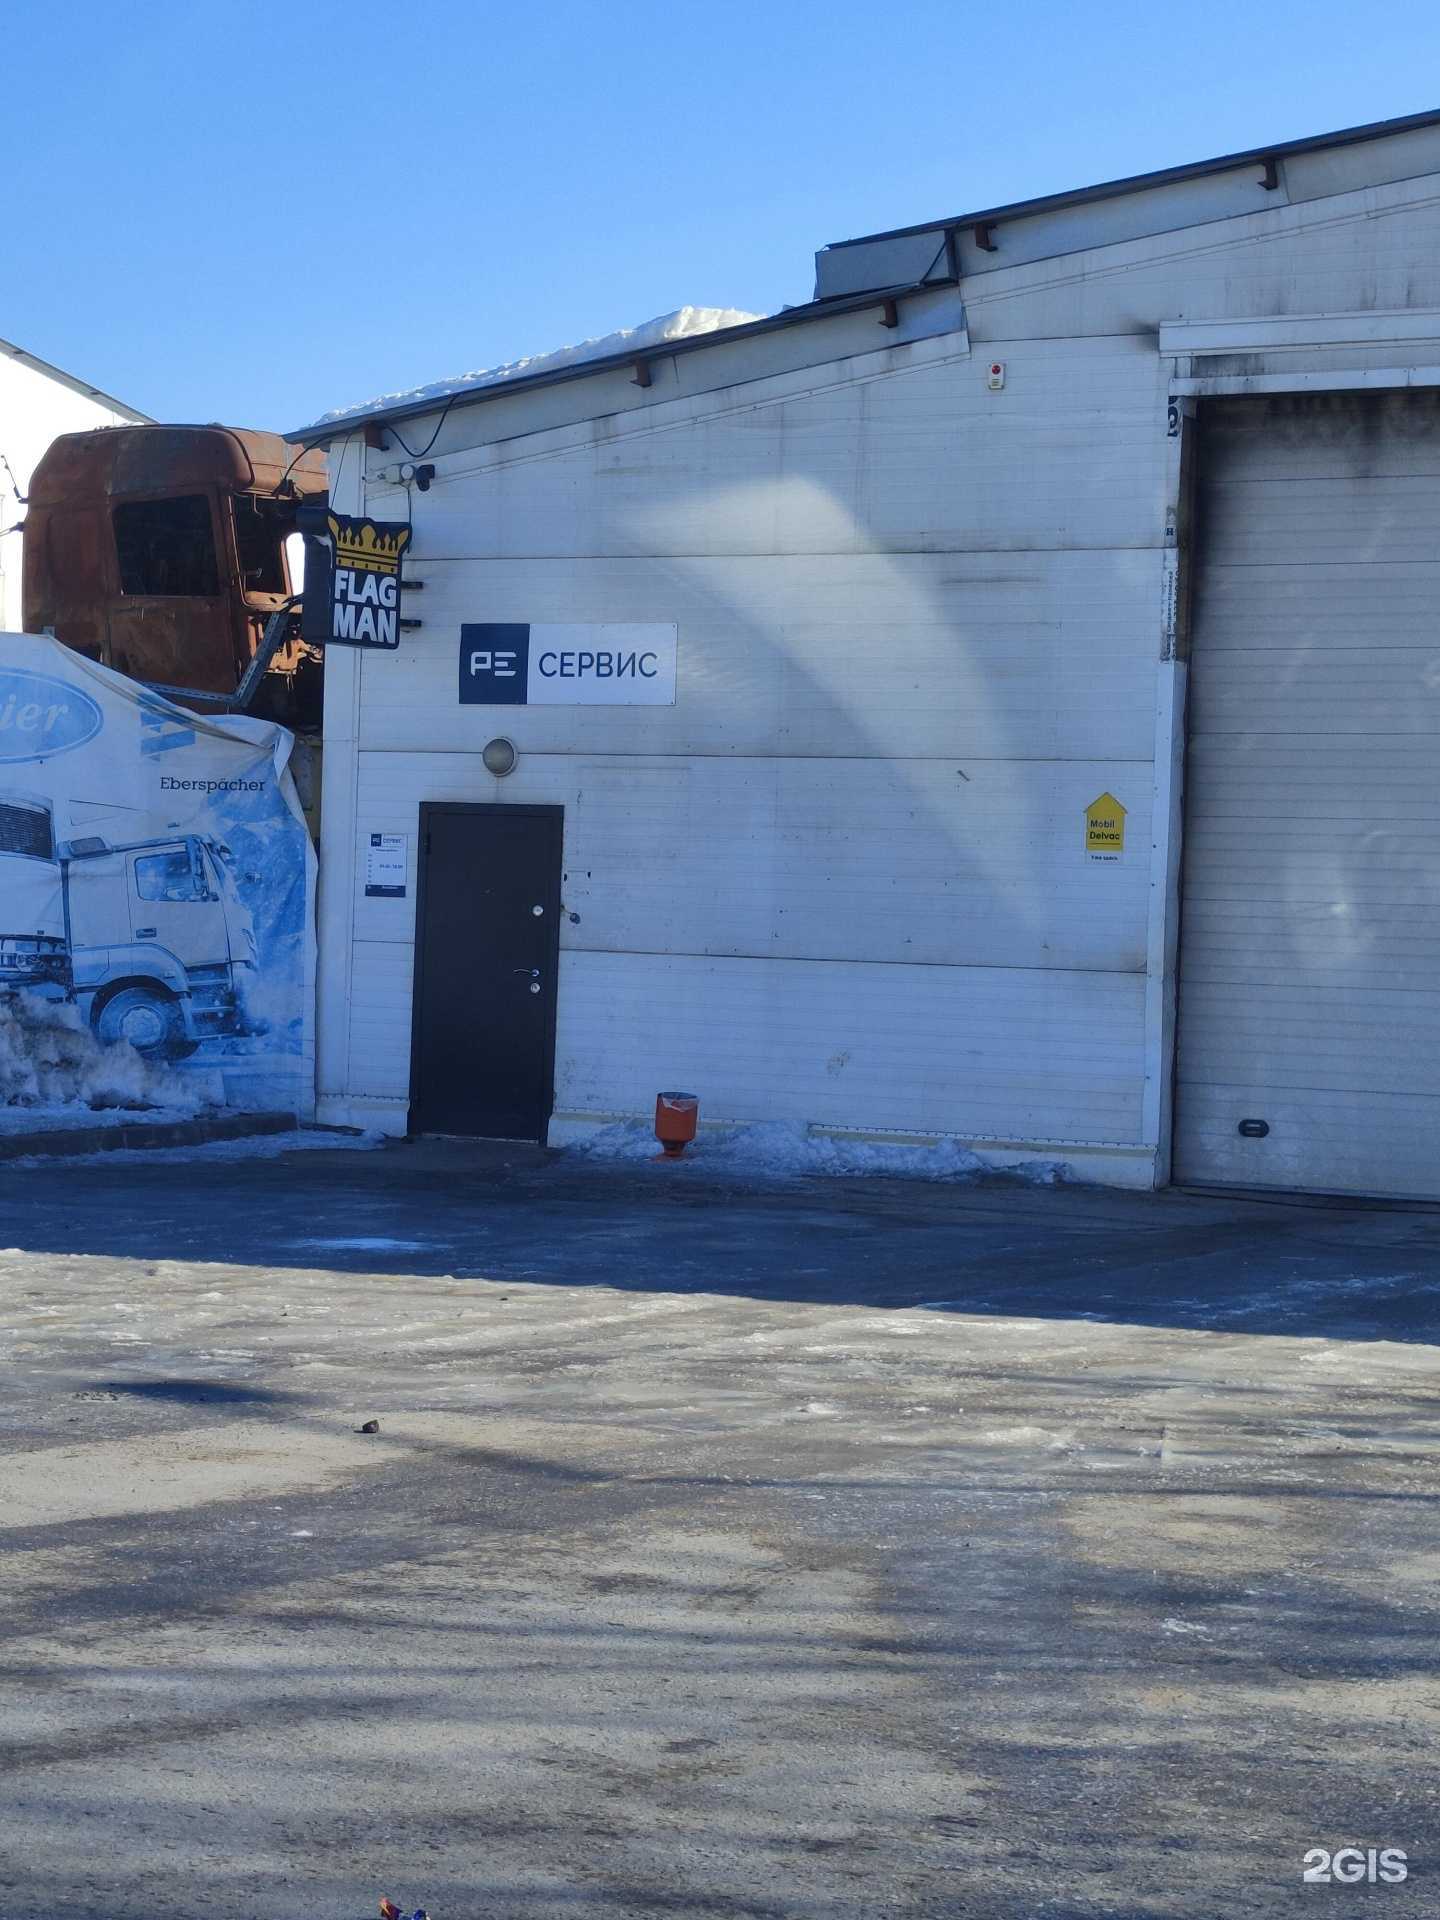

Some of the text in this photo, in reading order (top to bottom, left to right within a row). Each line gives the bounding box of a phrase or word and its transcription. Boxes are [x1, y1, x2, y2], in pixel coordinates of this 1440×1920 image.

[334, 569, 397, 608] FLAG
[333, 602, 397, 644] MAN
[539, 652, 658, 677] СЕРВИС
[0, 694, 70, 731] ier
[160, 776, 266, 794] Eberspächer
[1090, 819, 1115, 828] Mobil
